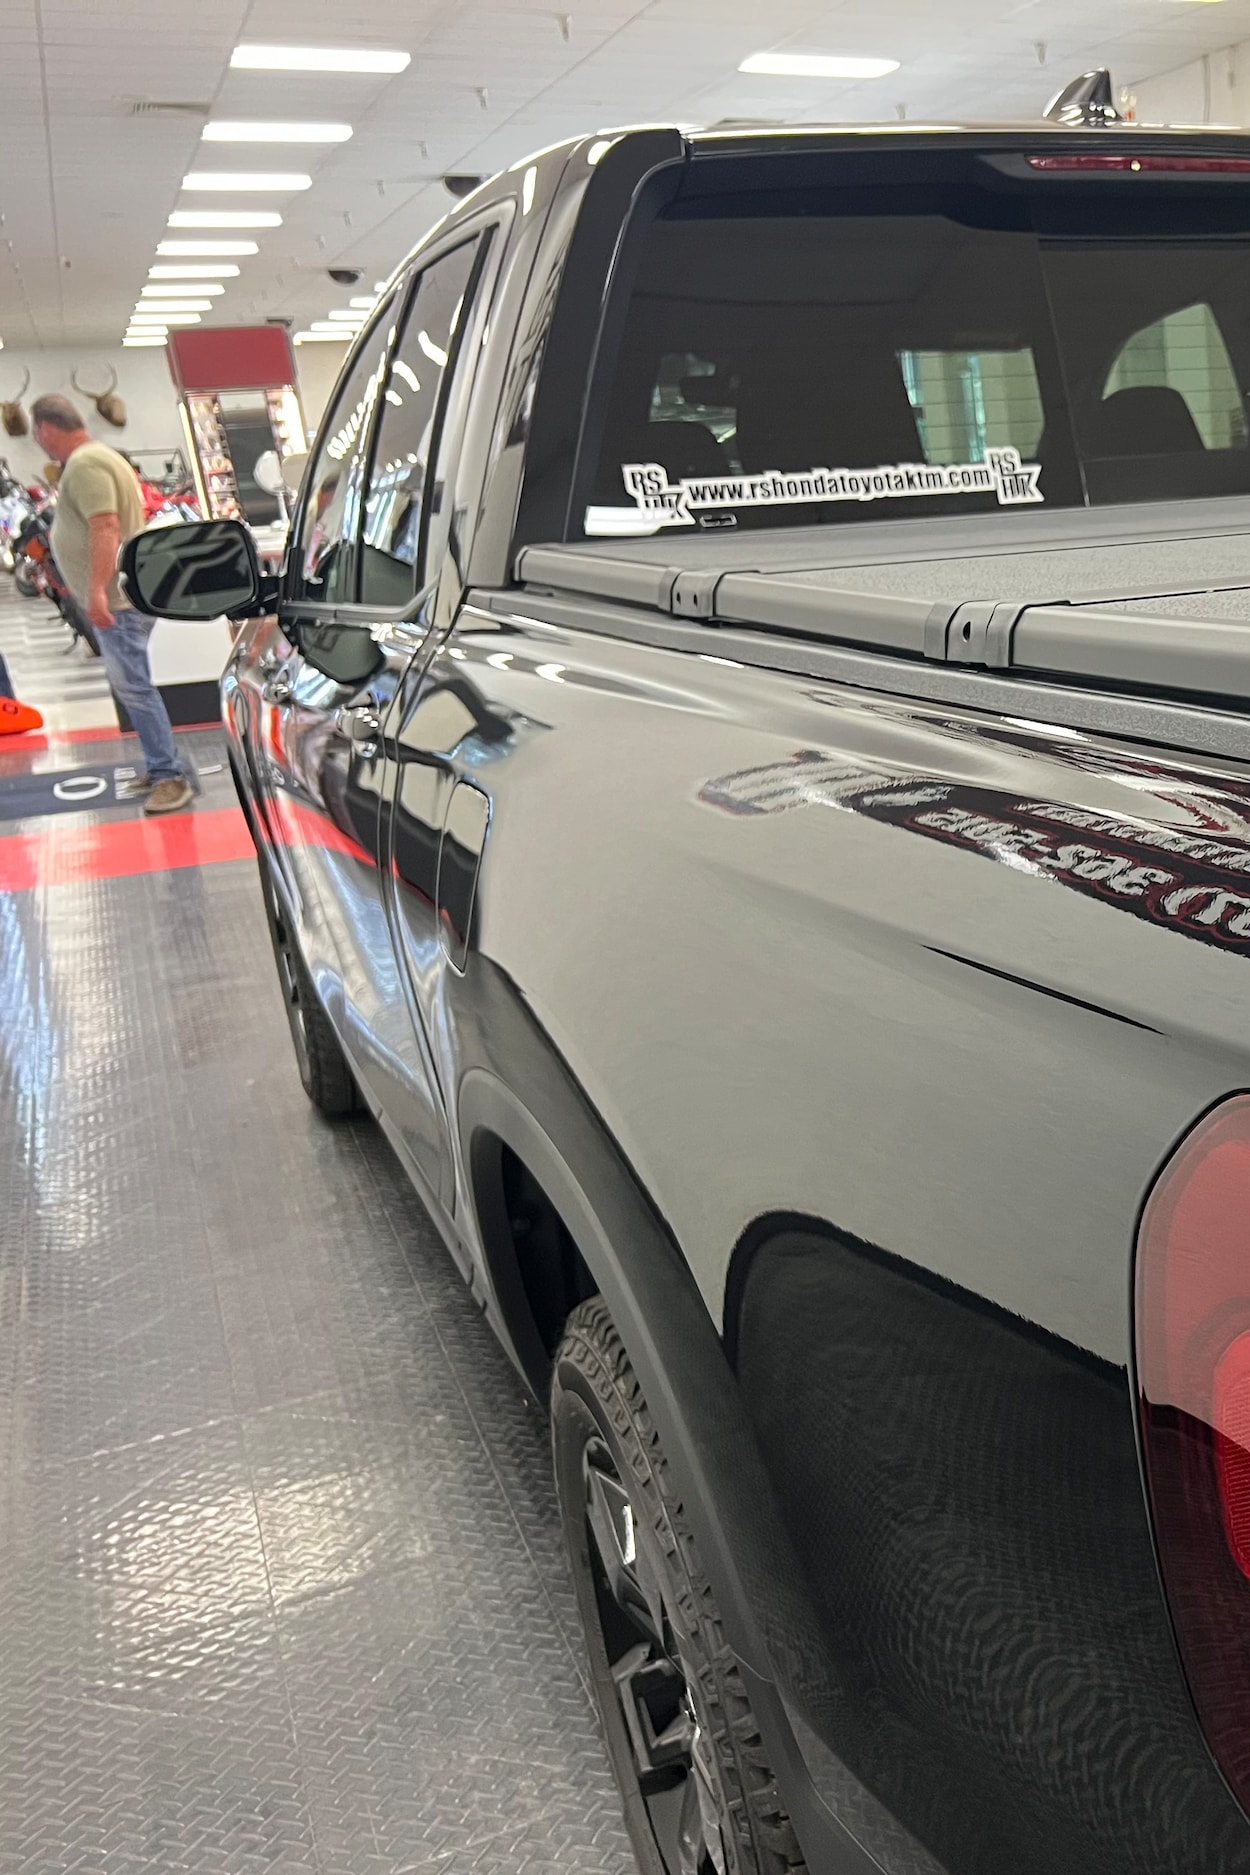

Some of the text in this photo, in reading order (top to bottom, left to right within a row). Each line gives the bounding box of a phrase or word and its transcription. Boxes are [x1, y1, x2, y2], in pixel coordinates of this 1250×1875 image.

[990, 452, 1016, 476] RS
[629, 469, 662, 496] RS
[688, 467, 991, 502] www.rshondatoyotaktm.com
